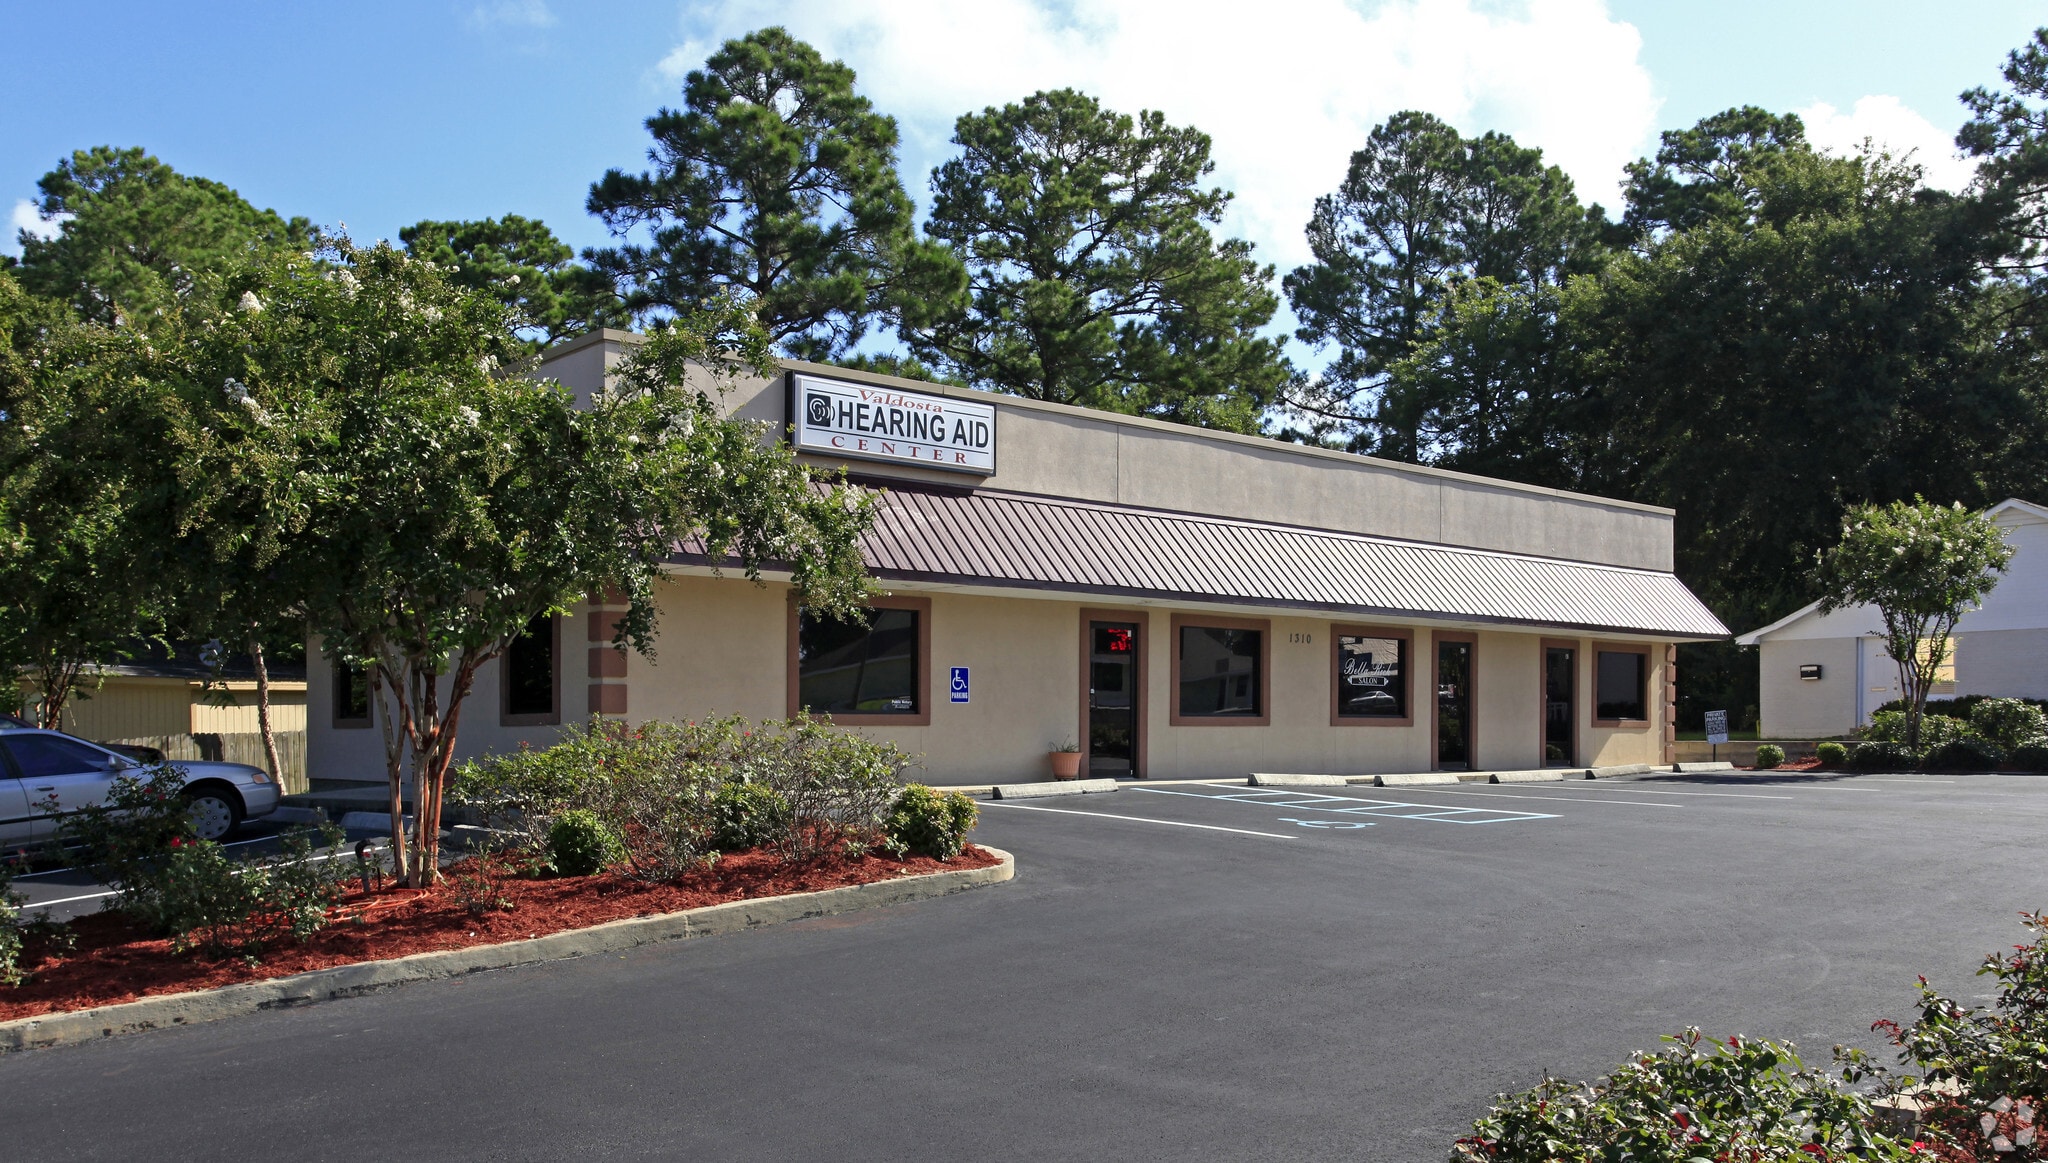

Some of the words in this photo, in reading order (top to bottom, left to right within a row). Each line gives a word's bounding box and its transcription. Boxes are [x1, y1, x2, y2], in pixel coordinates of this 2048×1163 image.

[859, 390, 943, 413] Valdosta
[839, 400, 945, 442] HEARING
[952, 418, 989, 448] AID
[831, 436, 967, 464] CENTER
[1289, 633, 1312, 644] 1310
[1344, 658, 1369, 675] Bella
[951, 691, 968, 699] PARKING
